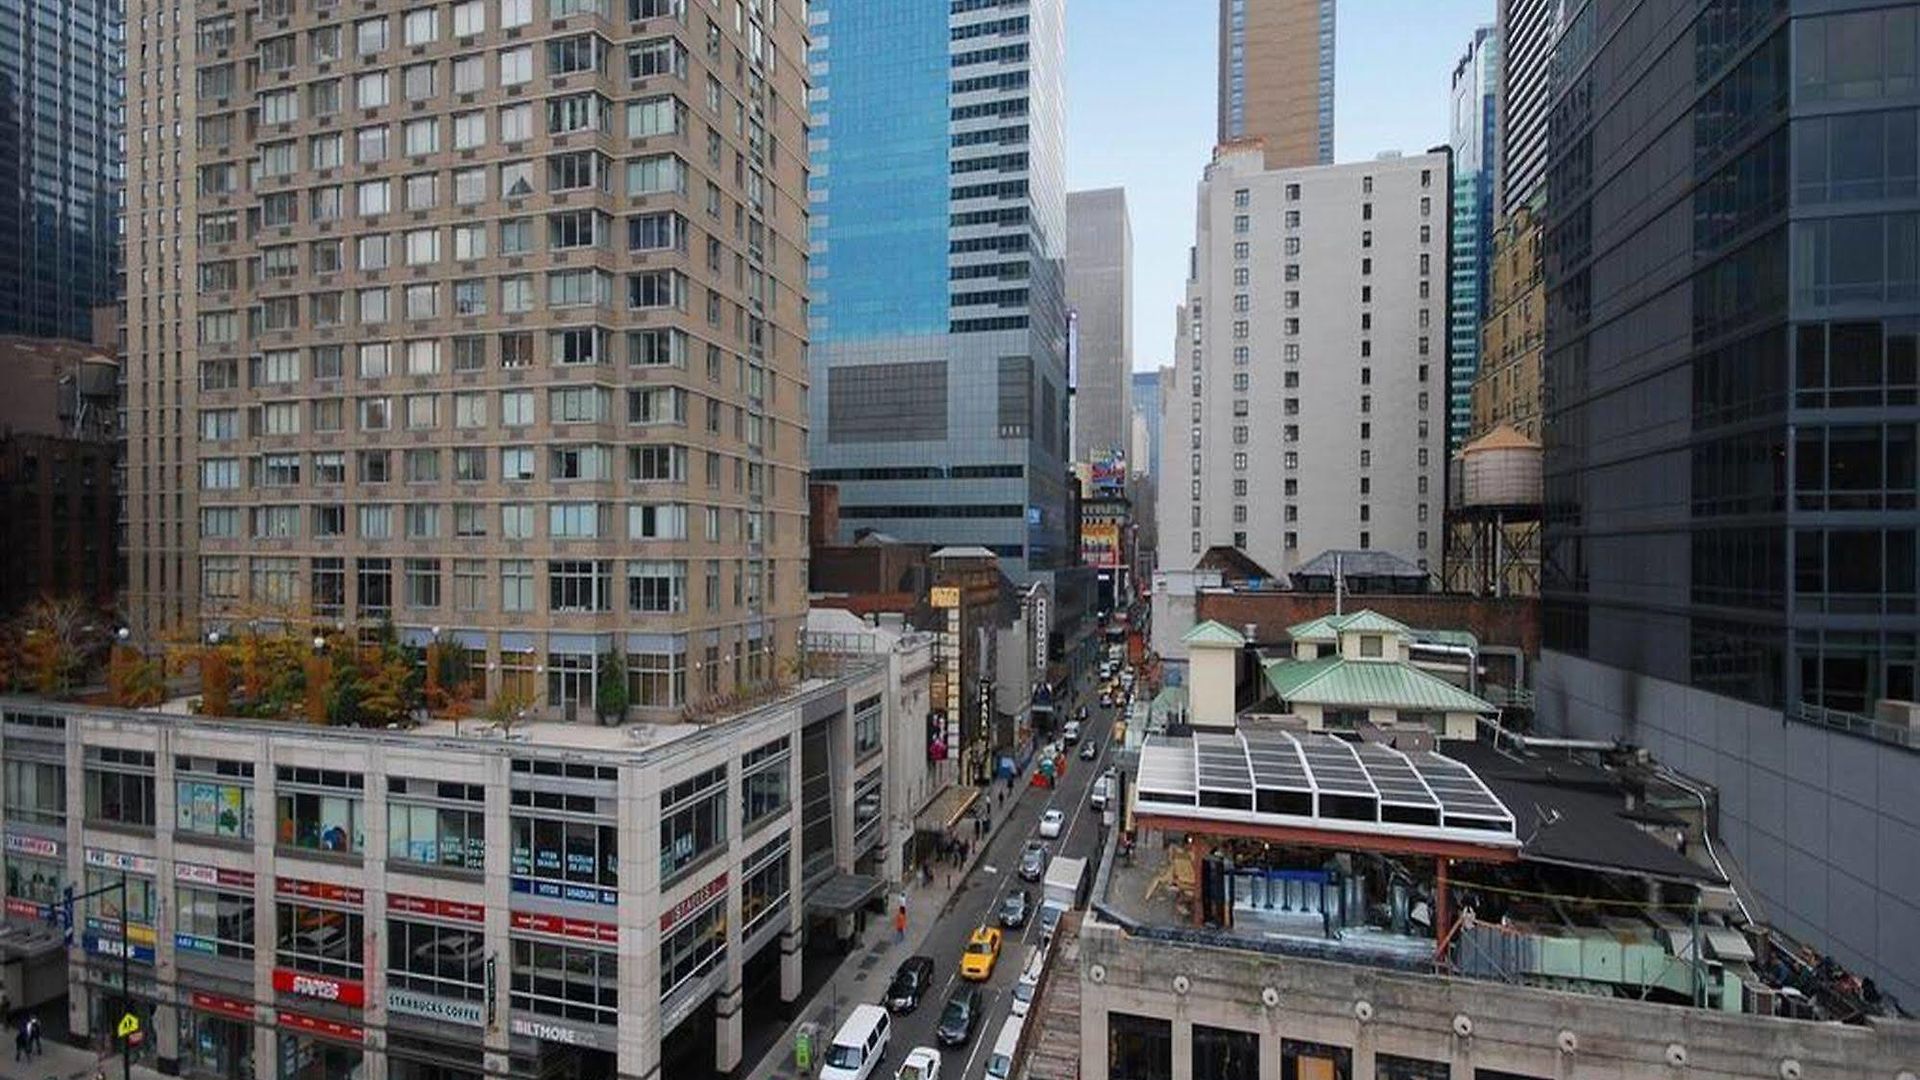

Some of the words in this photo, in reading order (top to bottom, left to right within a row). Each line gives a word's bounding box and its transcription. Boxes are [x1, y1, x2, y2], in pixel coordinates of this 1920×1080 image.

[389, 995, 444, 1015] STARBUCKS
[446, 1004, 481, 1022] COFFEE
[515, 1020, 576, 1044] BILTMORE
